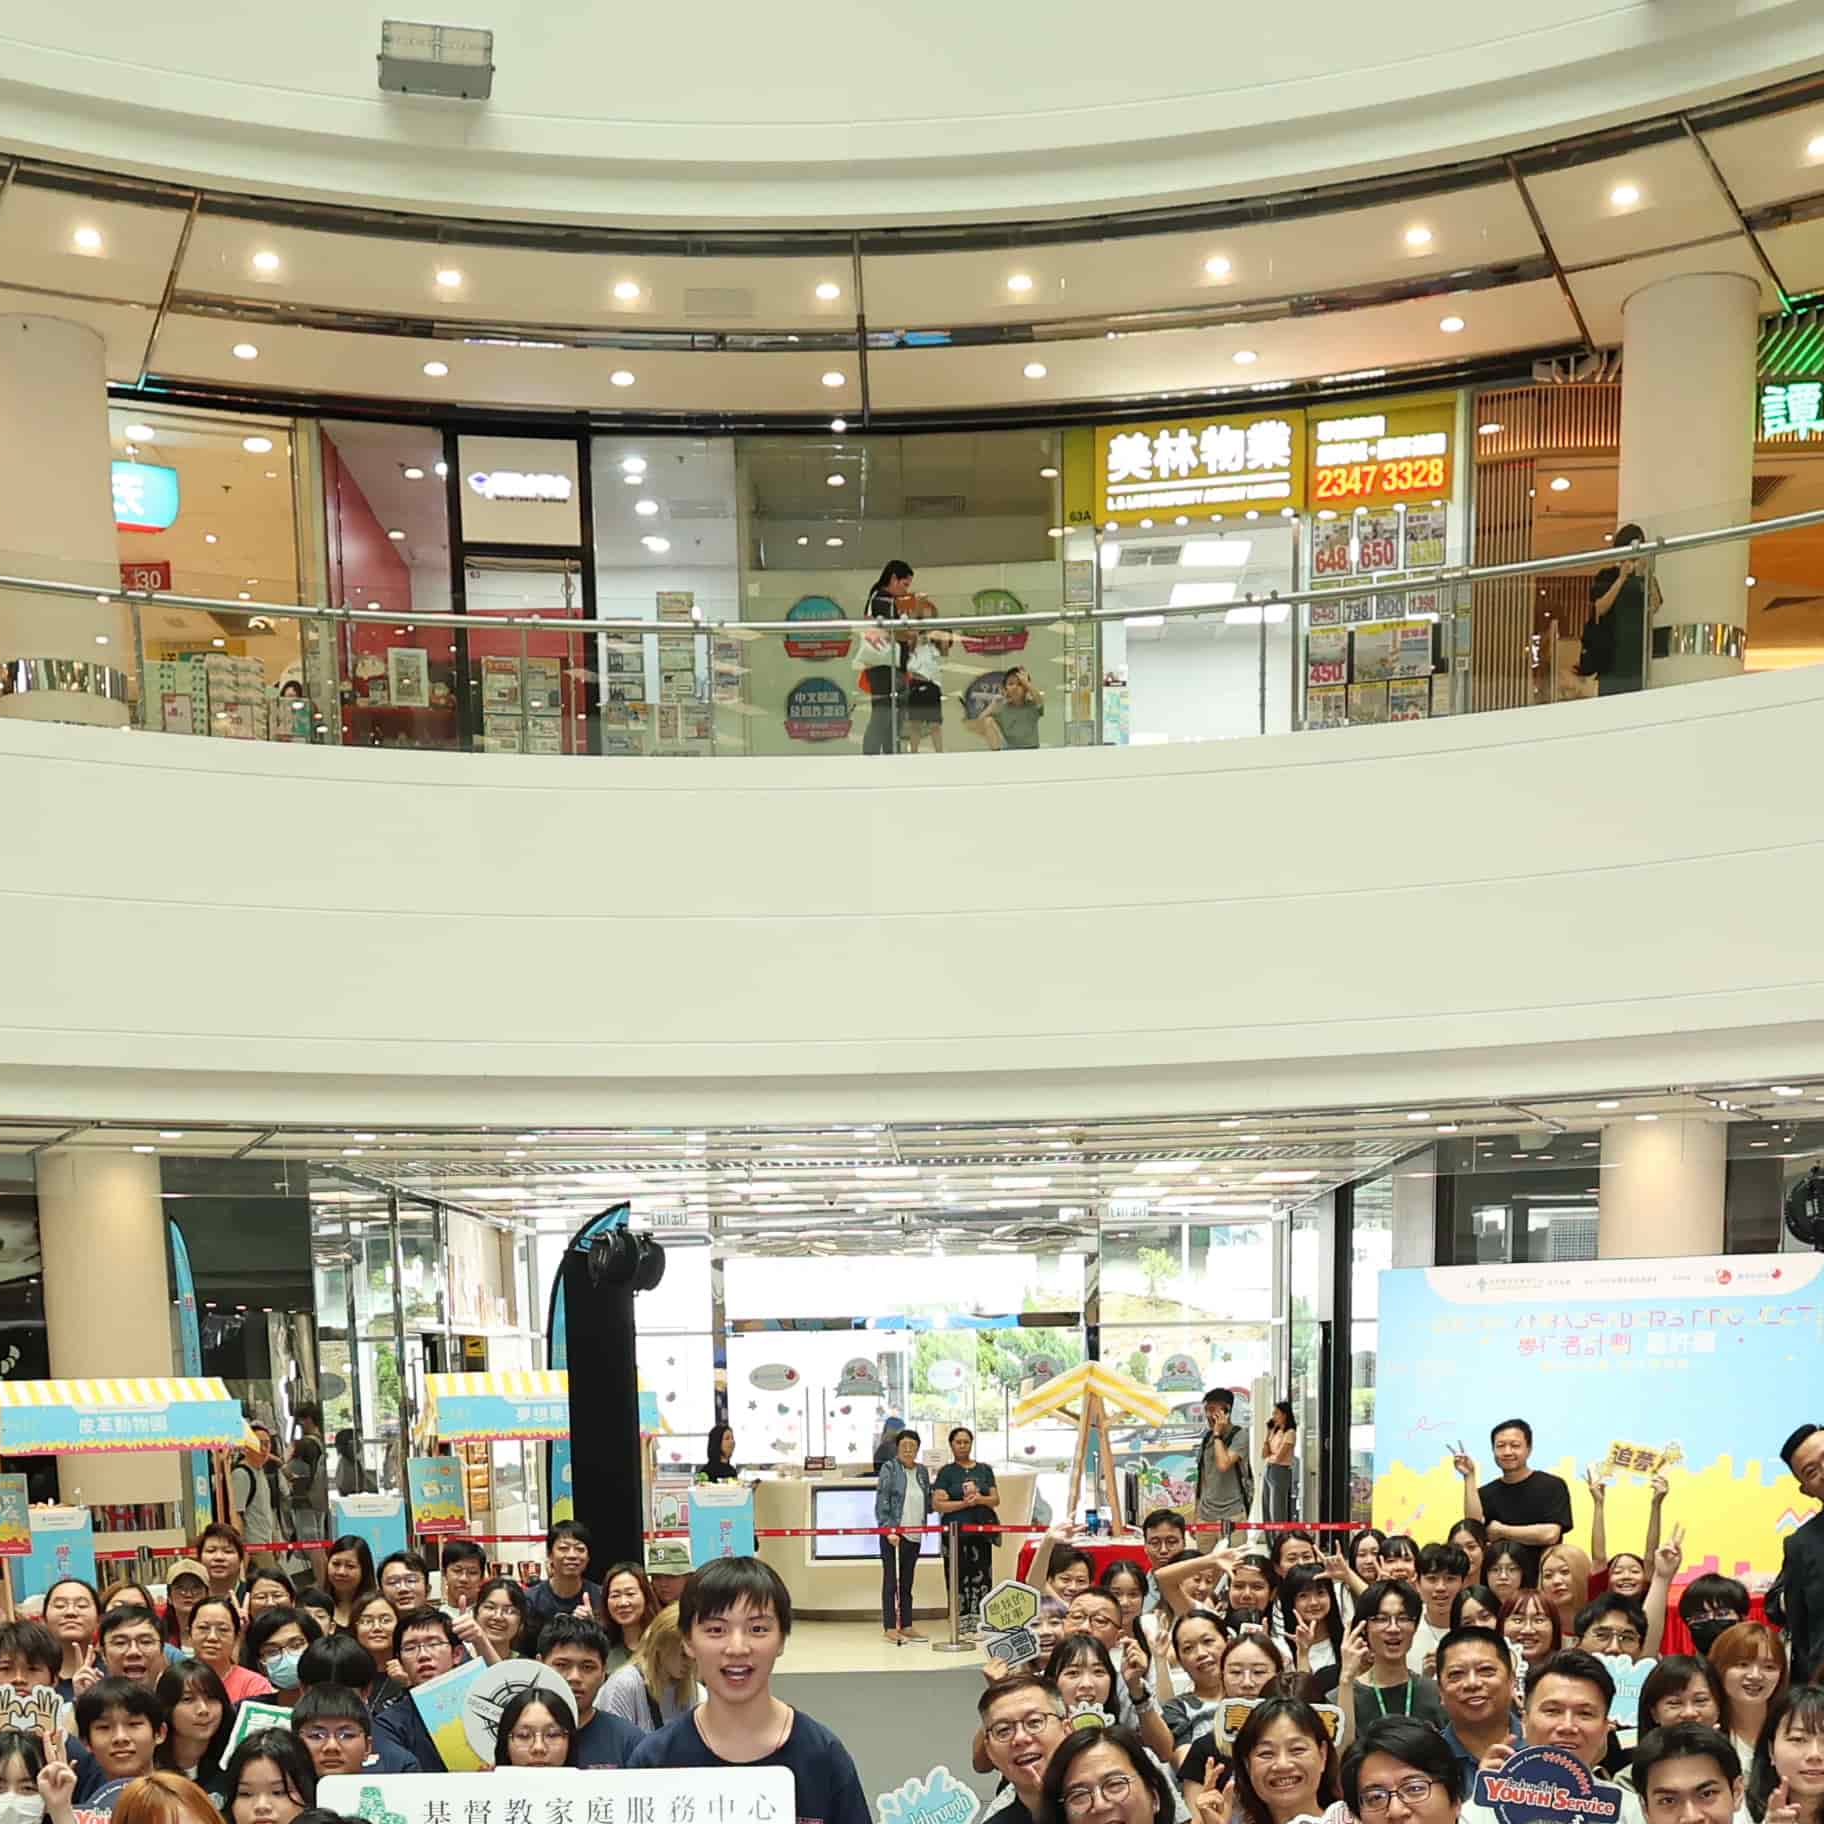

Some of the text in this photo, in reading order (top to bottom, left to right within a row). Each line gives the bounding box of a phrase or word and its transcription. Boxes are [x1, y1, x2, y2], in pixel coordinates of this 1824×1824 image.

[1107, 419, 1292, 483] 美林物業
[1317, 466, 1377, 498] 2347
[1382, 457, 1444, 490] 3328
[1551, 1784, 1619, 1817] Service
